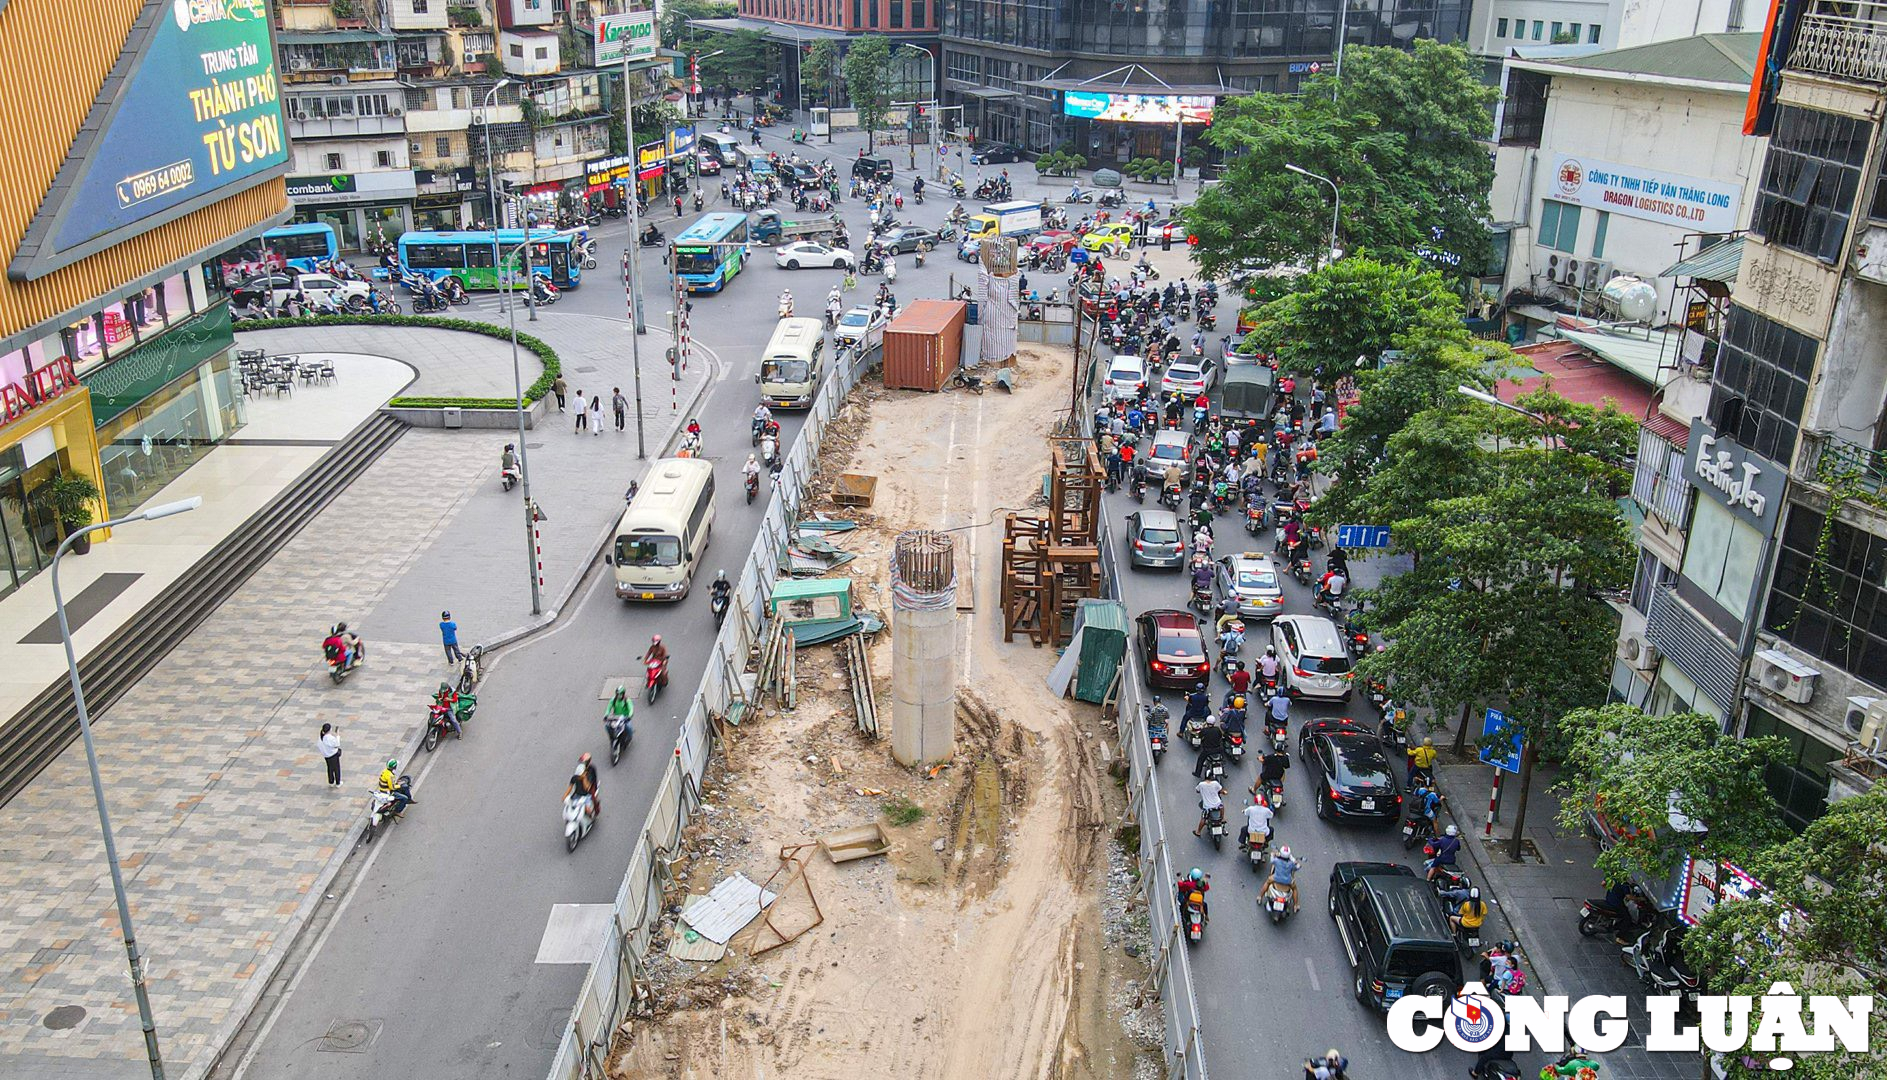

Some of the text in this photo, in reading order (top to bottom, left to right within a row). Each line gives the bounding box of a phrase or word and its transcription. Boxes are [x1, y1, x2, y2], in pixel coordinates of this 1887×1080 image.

[201, 41, 258, 75] TRUNG TÂM
[189, 64, 276, 122] THÀNH PHỐ
[203, 114, 281, 176] TỪ SƠN
[133, 162, 192, 199] 0969 64 0002
[1588, 168, 1608, 187] CÔNG
[1610, 174, 1620, 188] TY
[1620, 175, 1640, 191] TNHH
[1642, 178, 1659, 195] TIẾP
[1660, 183, 1677, 200] VẬN
[1706, 193, 1730, 208] LONG
[1603, 190, 1705, 222] DRAGON LOGISTICS CO.,LTD
[0, 355, 80, 428] ENTER
